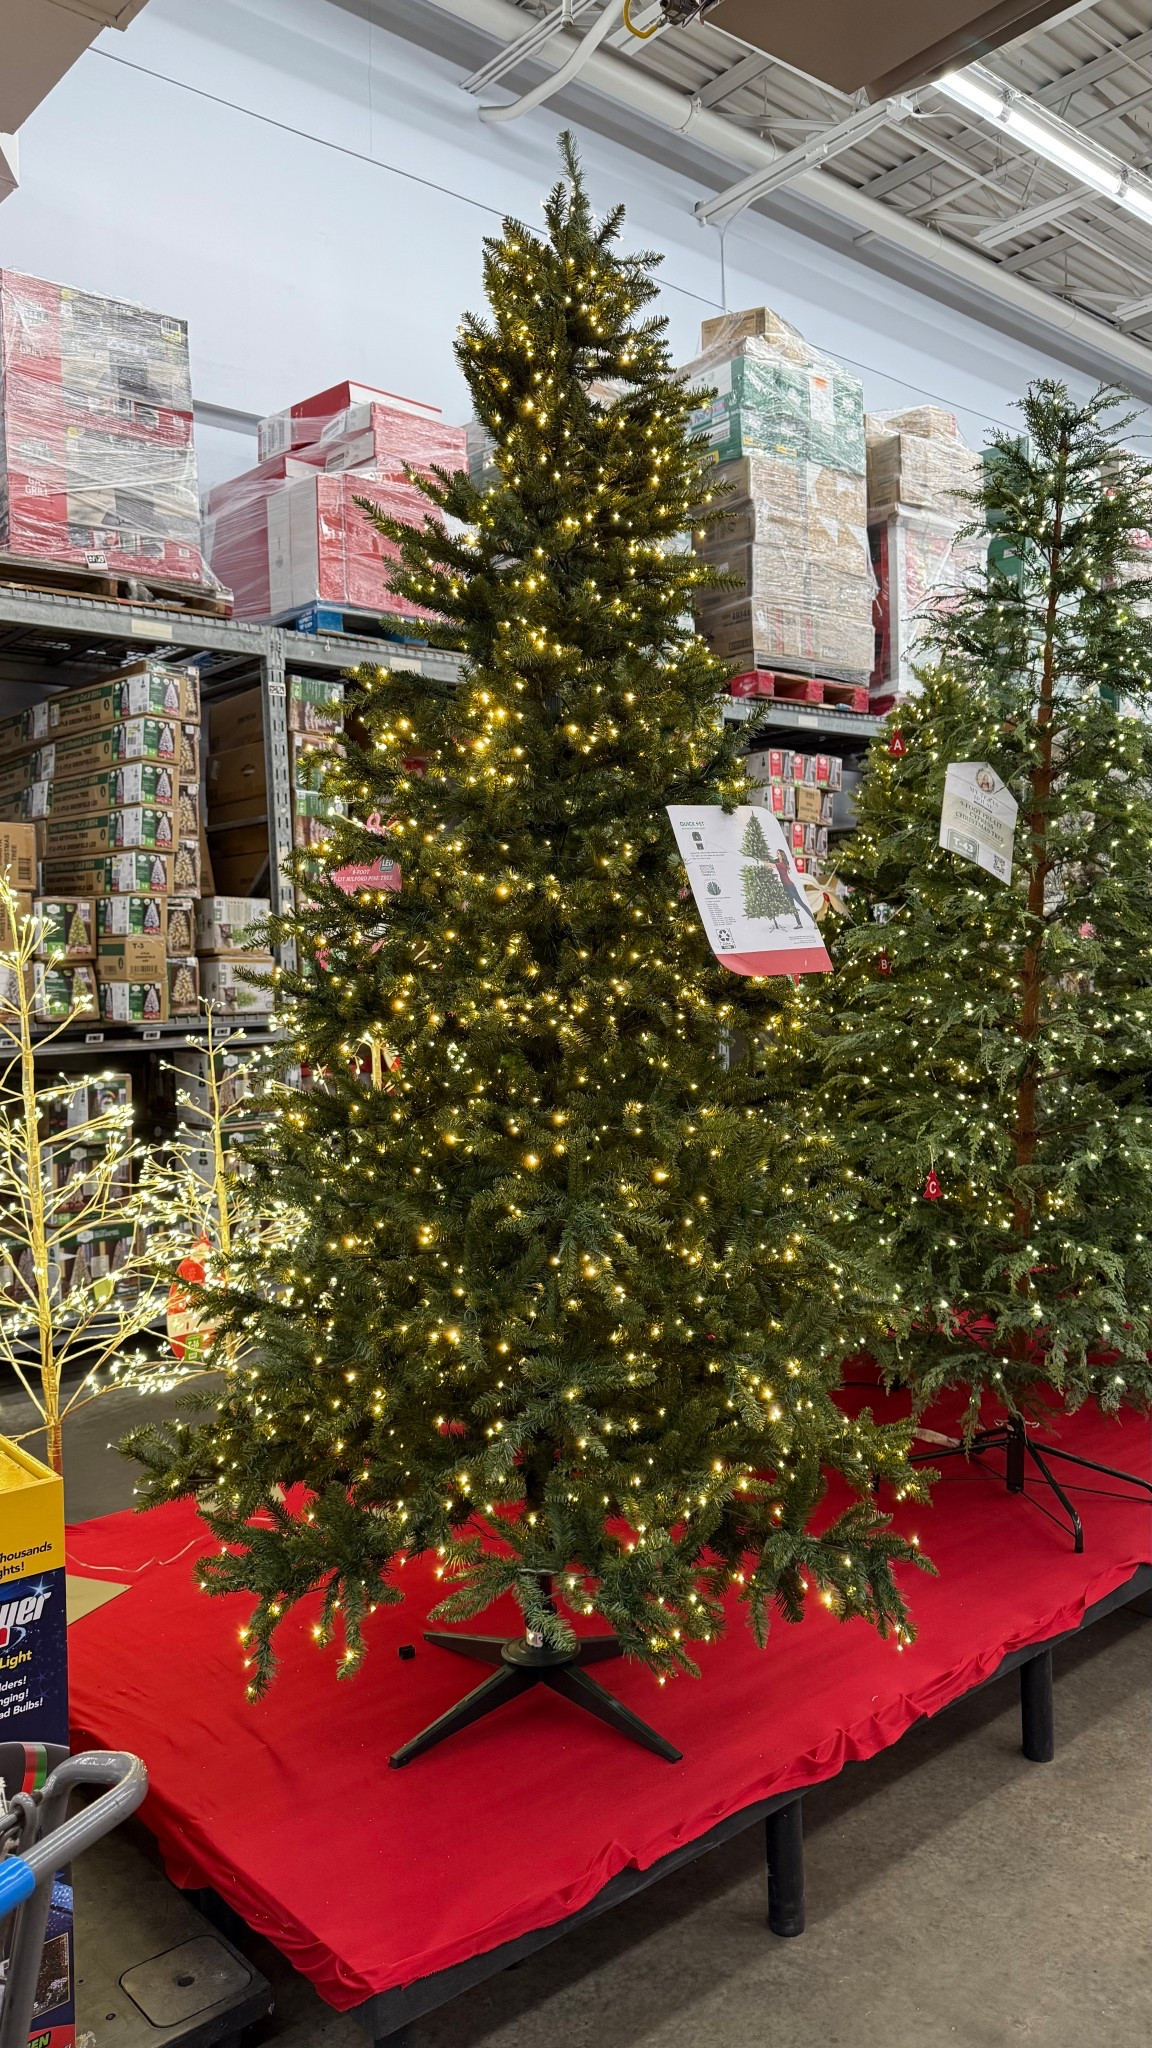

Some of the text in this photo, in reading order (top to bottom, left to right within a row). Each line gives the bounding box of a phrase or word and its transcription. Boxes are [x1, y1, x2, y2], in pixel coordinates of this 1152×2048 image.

[25, 485, 50, 497] GRILL
[893, 739, 902, 751] A
[955, 811, 1004, 844] CHRISTMAS TREE
[969, 811, 994, 830] CYPRESS
[953, 837, 974, 853] T-43
[382, 859, 394, 867] LED
[881, 959, 888, 970] B
[929, 1181, 937, 1194] C
[0, 1541, 53, 1563] housands
[0, 1650, 32, 1670] Light
[13, 1697, 44, 1715] Bulbs!
